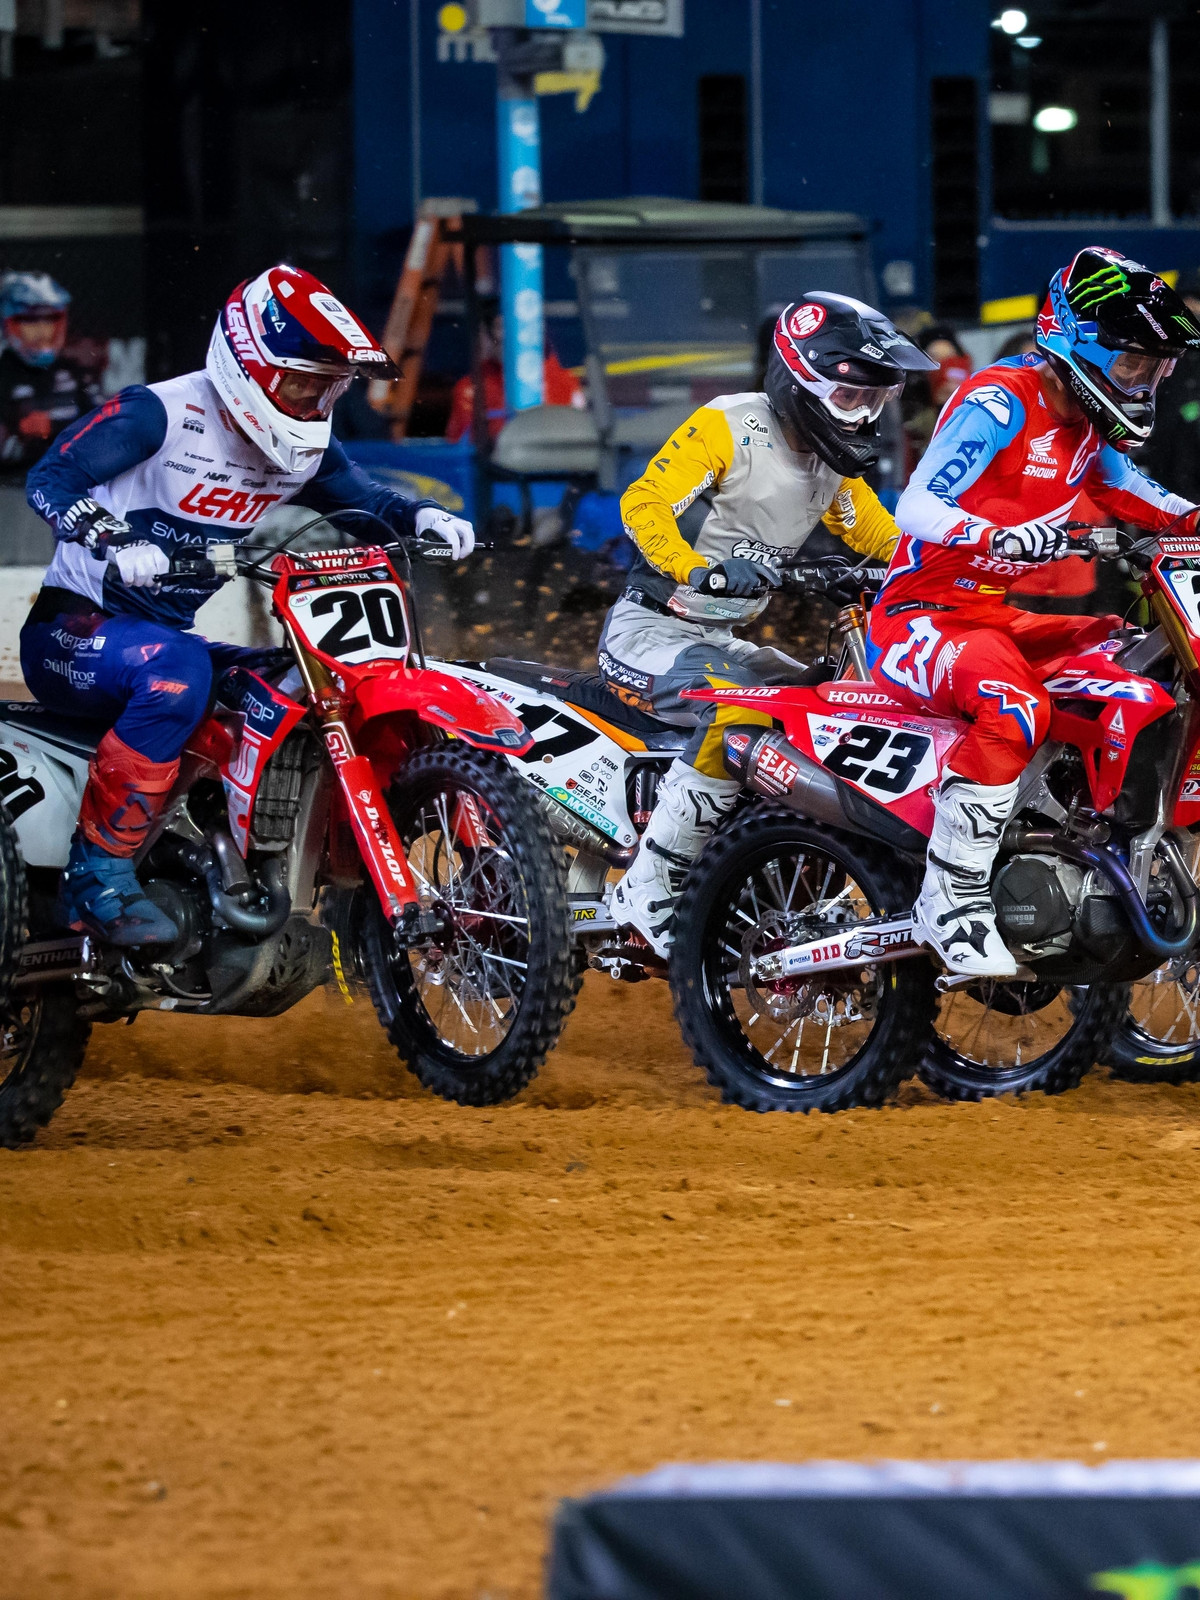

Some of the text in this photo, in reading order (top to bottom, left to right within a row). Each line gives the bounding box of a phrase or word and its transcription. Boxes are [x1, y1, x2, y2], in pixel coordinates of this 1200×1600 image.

[1068, 371, 1102, 413] MONSTER
[1027, 453, 1058, 465] HONDA
[163, 460, 197, 475] SHOWA
[1022, 465, 1058, 479] SHOWA
[178, 483, 283, 523] LEATT
[752, 542, 780, 555] ROCKY
[328, 572, 370, 582] MONSTER
[310, 588, 407, 658] 20
[948, 641, 968, 690] HONDA
[618, 666, 650, 682] MOUNTAIN
[714, 689, 780, 697] DUNLOP
[815, 723, 842, 735] AMA
[881, 717, 899, 727] Power
[513, 703, 601, 763] 17
[822, 724, 931, 794] 23
[527, 772, 549, 789] KTM
[572, 790, 585, 799] OFF
[575, 784, 606, 808] GEAR
[566, 799, 616, 835] MOTOREX
